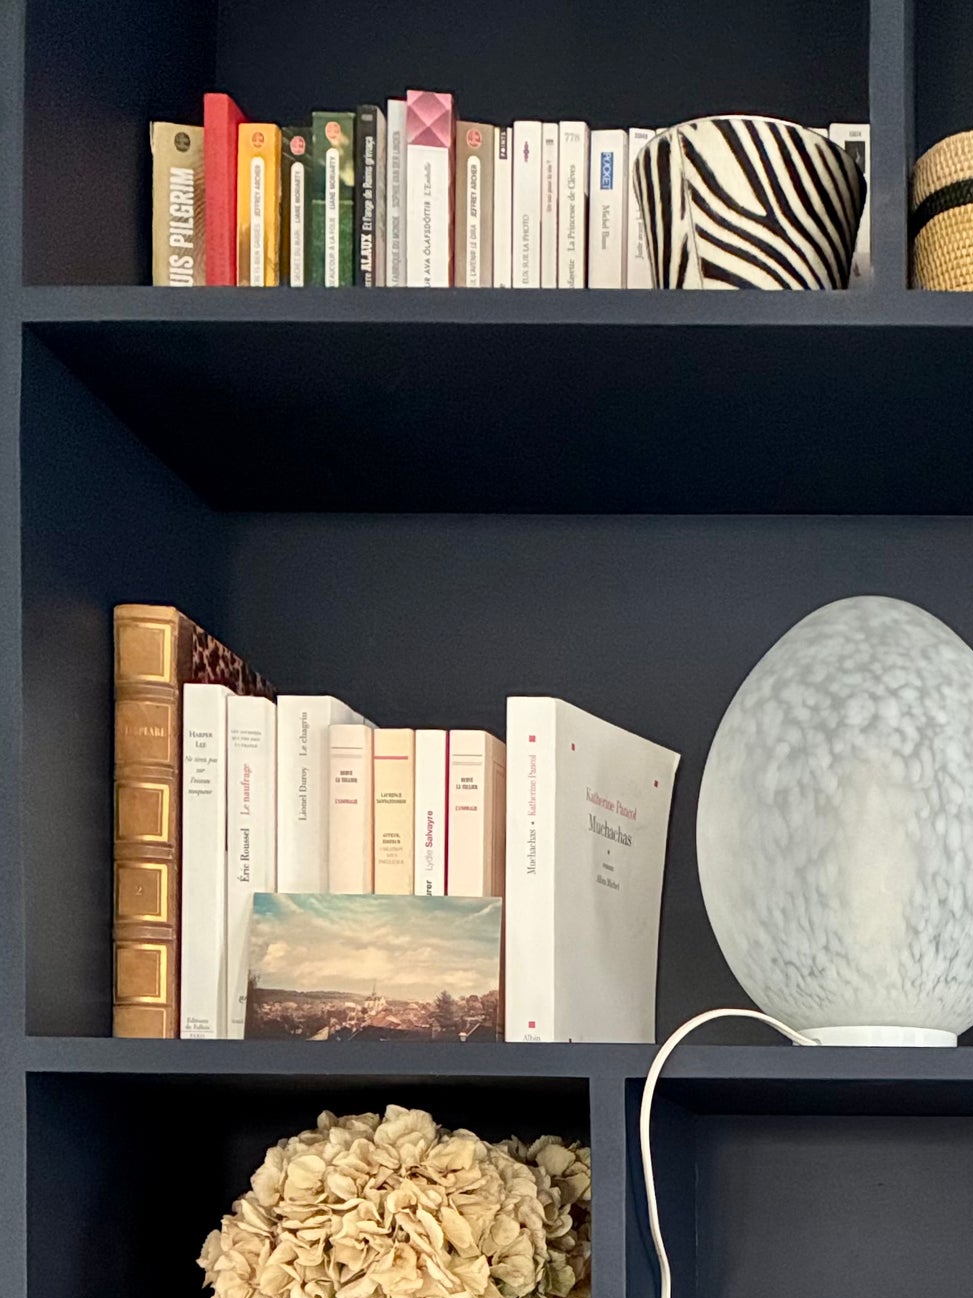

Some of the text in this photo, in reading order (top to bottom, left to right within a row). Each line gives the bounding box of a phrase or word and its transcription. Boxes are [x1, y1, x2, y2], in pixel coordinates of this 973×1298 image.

[327, 156, 338, 210] LIANE MORIARTY
[469, 164, 479, 218] JEFFREY ARCHER
[601, 152, 613, 189] POCKET
[169, 166, 194, 248] PILGRIM
[566, 163, 576, 252] La Princesse de Clèves
[360, 233, 373, 272] ALAUX
[422, 258, 431, 275] AVA
[299, 711, 308, 757] Le chagrin
[241, 762, 252, 816] Le naufrage
[298, 767, 308, 821] Lionel Duroy
[528, 754, 537, 816] Katherine Pancol
[586, 786, 638, 821] Katherine Pancol
[238, 827, 250, 882] Éric Roussel
[424, 811, 434, 871] Lydie Salvayre
[527, 829, 536, 875] Muchachas
[588, 813, 633, 848] Muchachas
